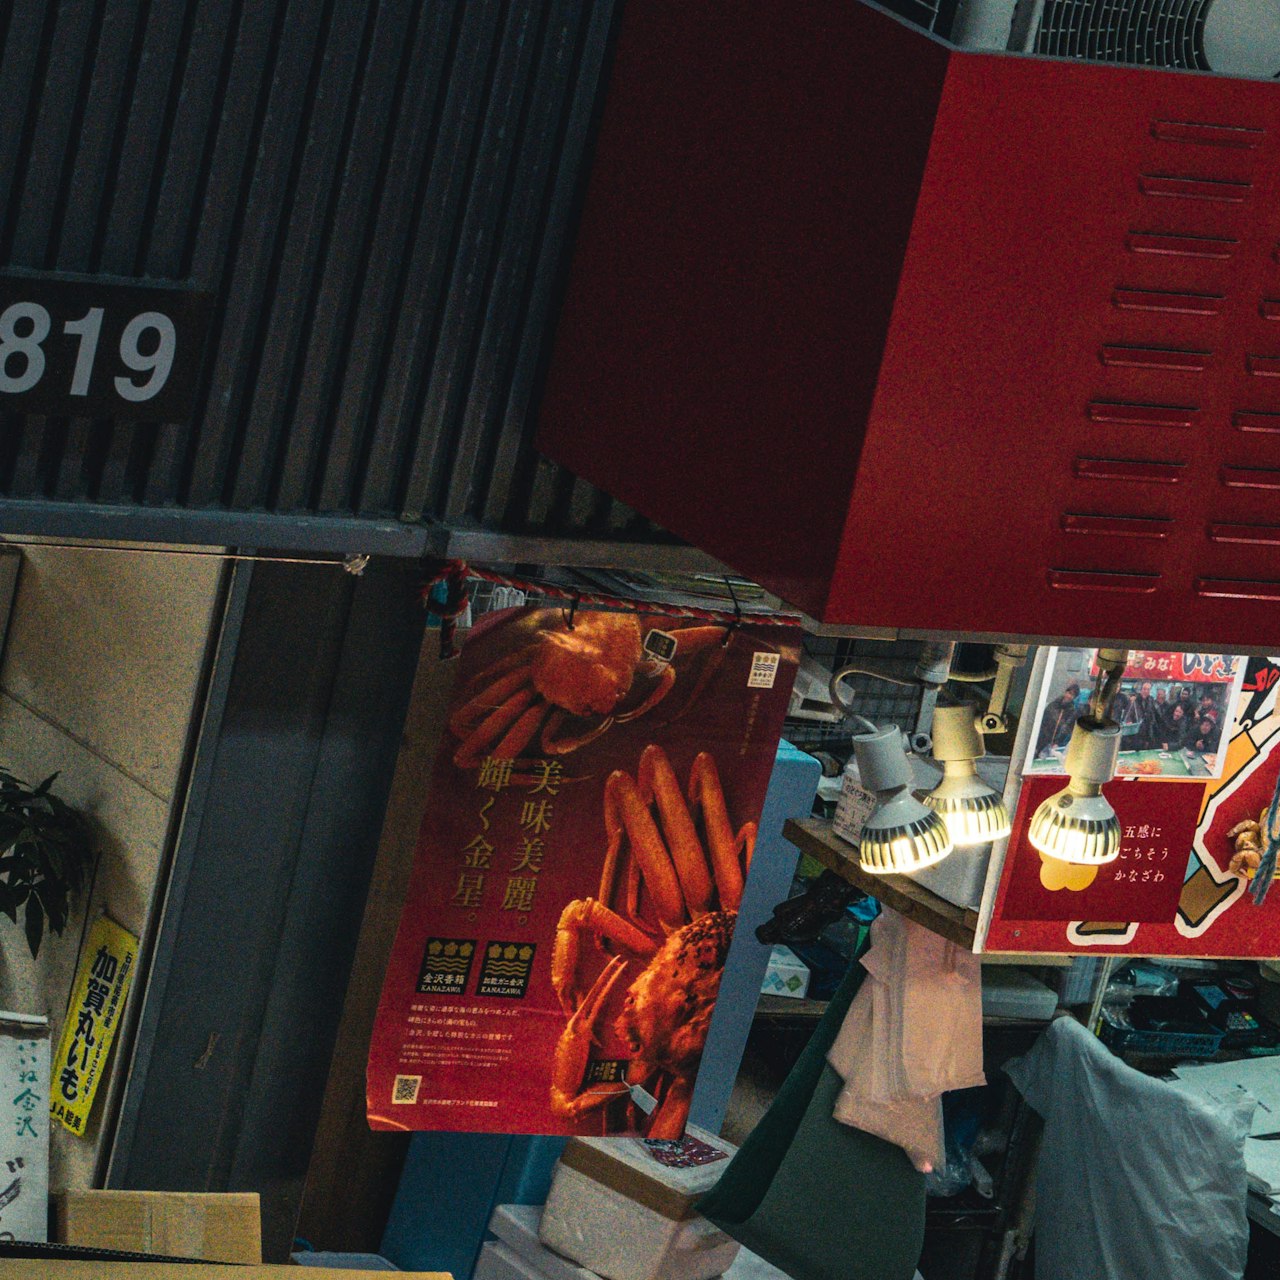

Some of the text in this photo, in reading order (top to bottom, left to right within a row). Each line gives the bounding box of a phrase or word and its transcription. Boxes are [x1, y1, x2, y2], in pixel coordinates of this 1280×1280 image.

[0, 302, 176, 402] 819
[451, 754, 511, 924] 輝く金星。
[502, 760, 564, 926] 美味美麗。
[1123, 826, 1162, 839] 五感に
[1114, 869, 1165, 883] かなざわ
[421, 985, 461, 994] KANAZAWA
[480, 986, 522, 996] KANAZAWA
[59, 945, 118, 1101] 加賀丸いも
